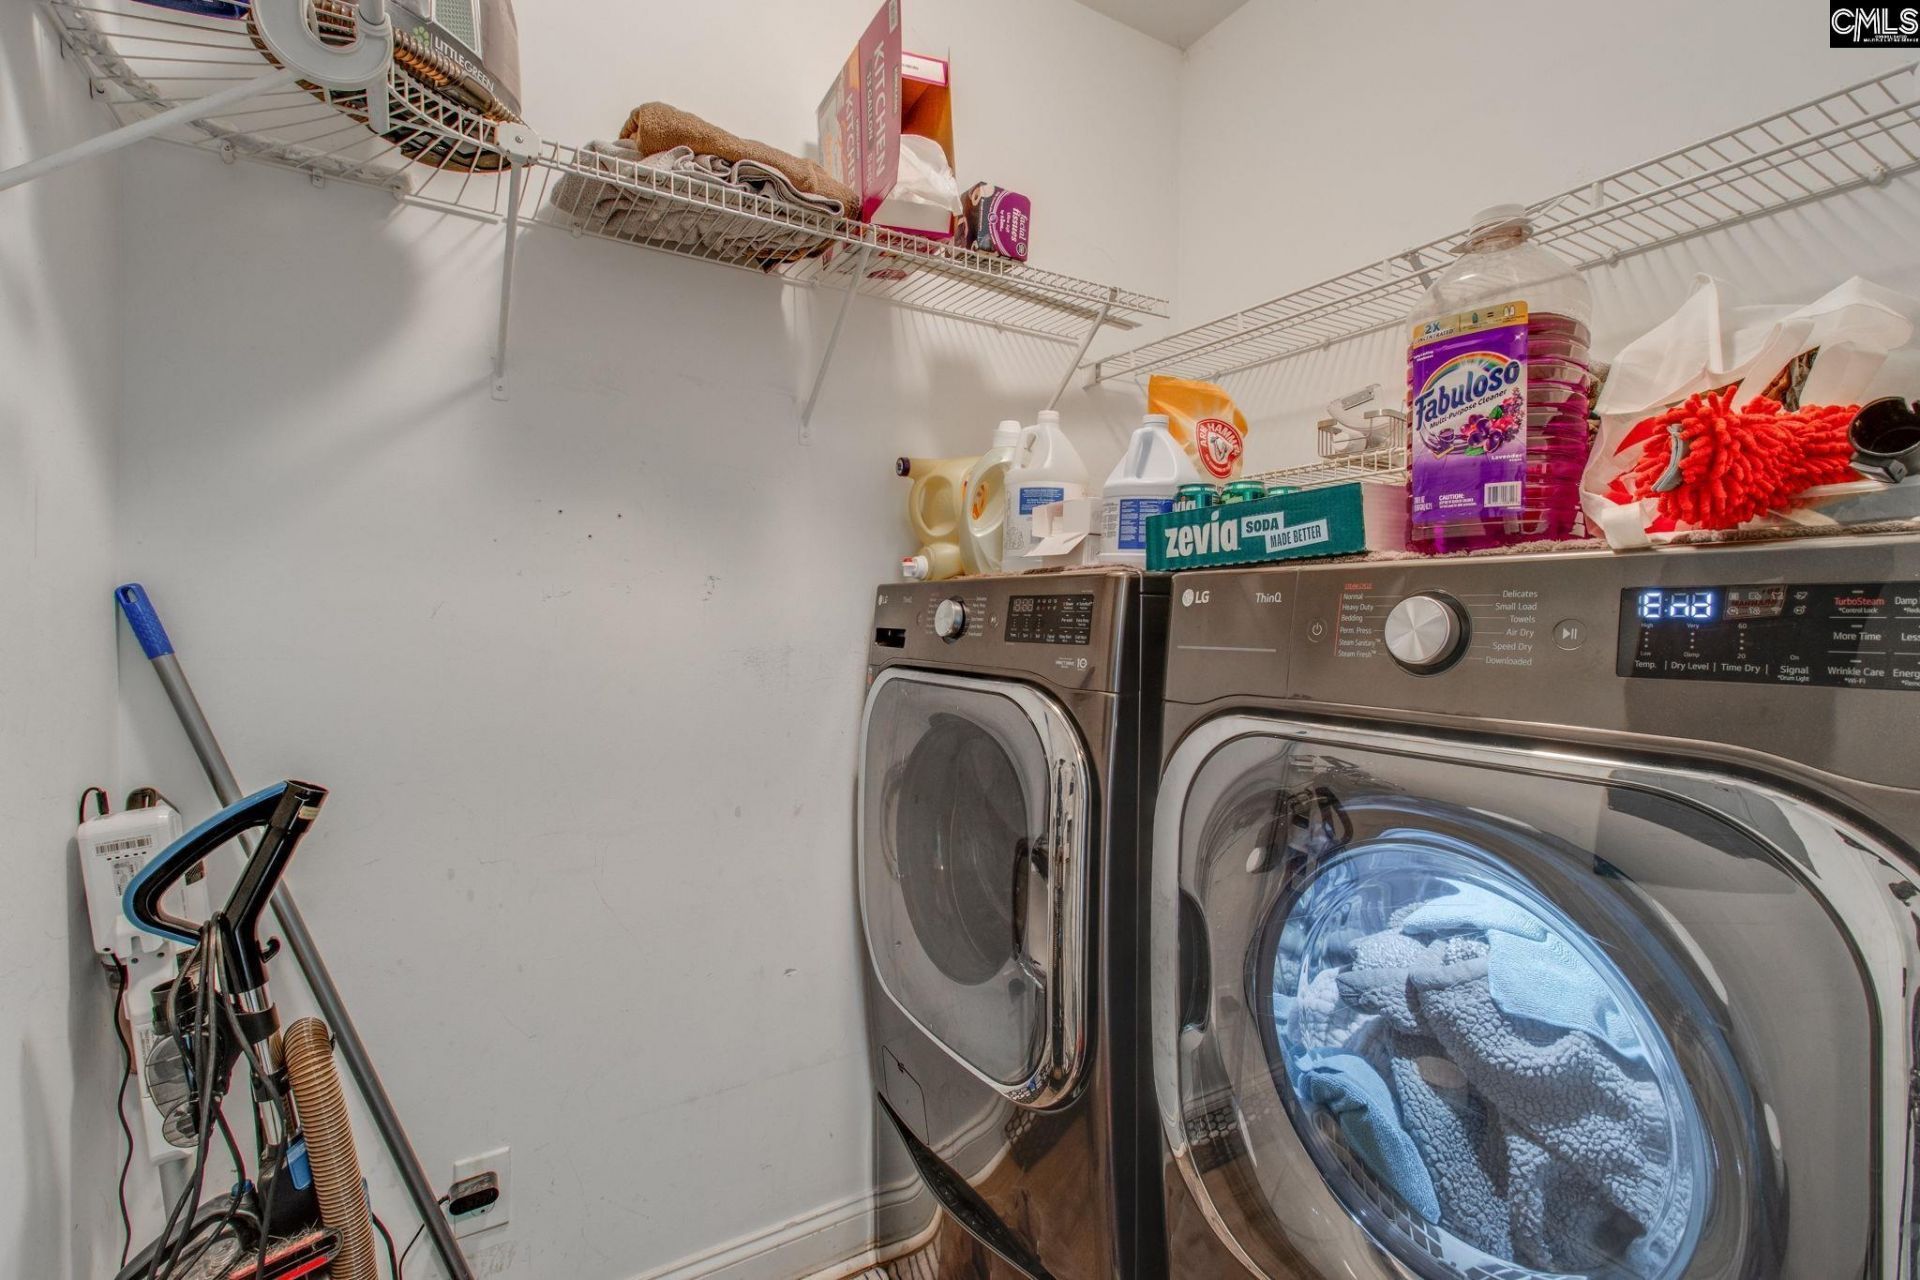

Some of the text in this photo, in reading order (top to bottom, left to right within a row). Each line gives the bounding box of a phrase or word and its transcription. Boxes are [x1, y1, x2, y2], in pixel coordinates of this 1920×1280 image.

[874, 40, 886, 178] KITCHEN
[1011, 207, 1021, 242] tissues
[1018, 213, 1028, 241] facial
[1423, 321, 1441, 335] 2X
[1415, 360, 1521, 431] Fabuloso
[1429, 389, 1508, 429] Multi-Purpose Cleaner
[1491, 452, 1523, 461] Lavender
[1245, 517, 1280, 534] SODA
[1164, 511, 1240, 559] zevia
[1269, 525, 1322, 549] MADE BETTER
[1194, 591, 1210, 604] LG
[1255, 592, 1283, 603] ThinQ
[1502, 589, 1538, 599] Delicates
[1495, 602, 1537, 611] Small Load
[1834, 596, 1886, 607] TurboSteam
[1894, 596, 1918, 607] Damp
[1509, 615, 1536, 624] Towels
[1506, 628, 1535, 638] Air Dry
[1832, 631, 1882, 641] More Time
[1492, 642, 1533, 653] Speed Dry
[1485, 655, 1533, 667] Downloaded
[1635, 660, 1657, 669] Temp.
[1670, 661, 1710, 671] Dry Level
[1721, 663, 1761, 675] Time Dry
[1780, 665, 1809, 676] Signal
[1827, 665, 1885, 677] Wrinkle Care
